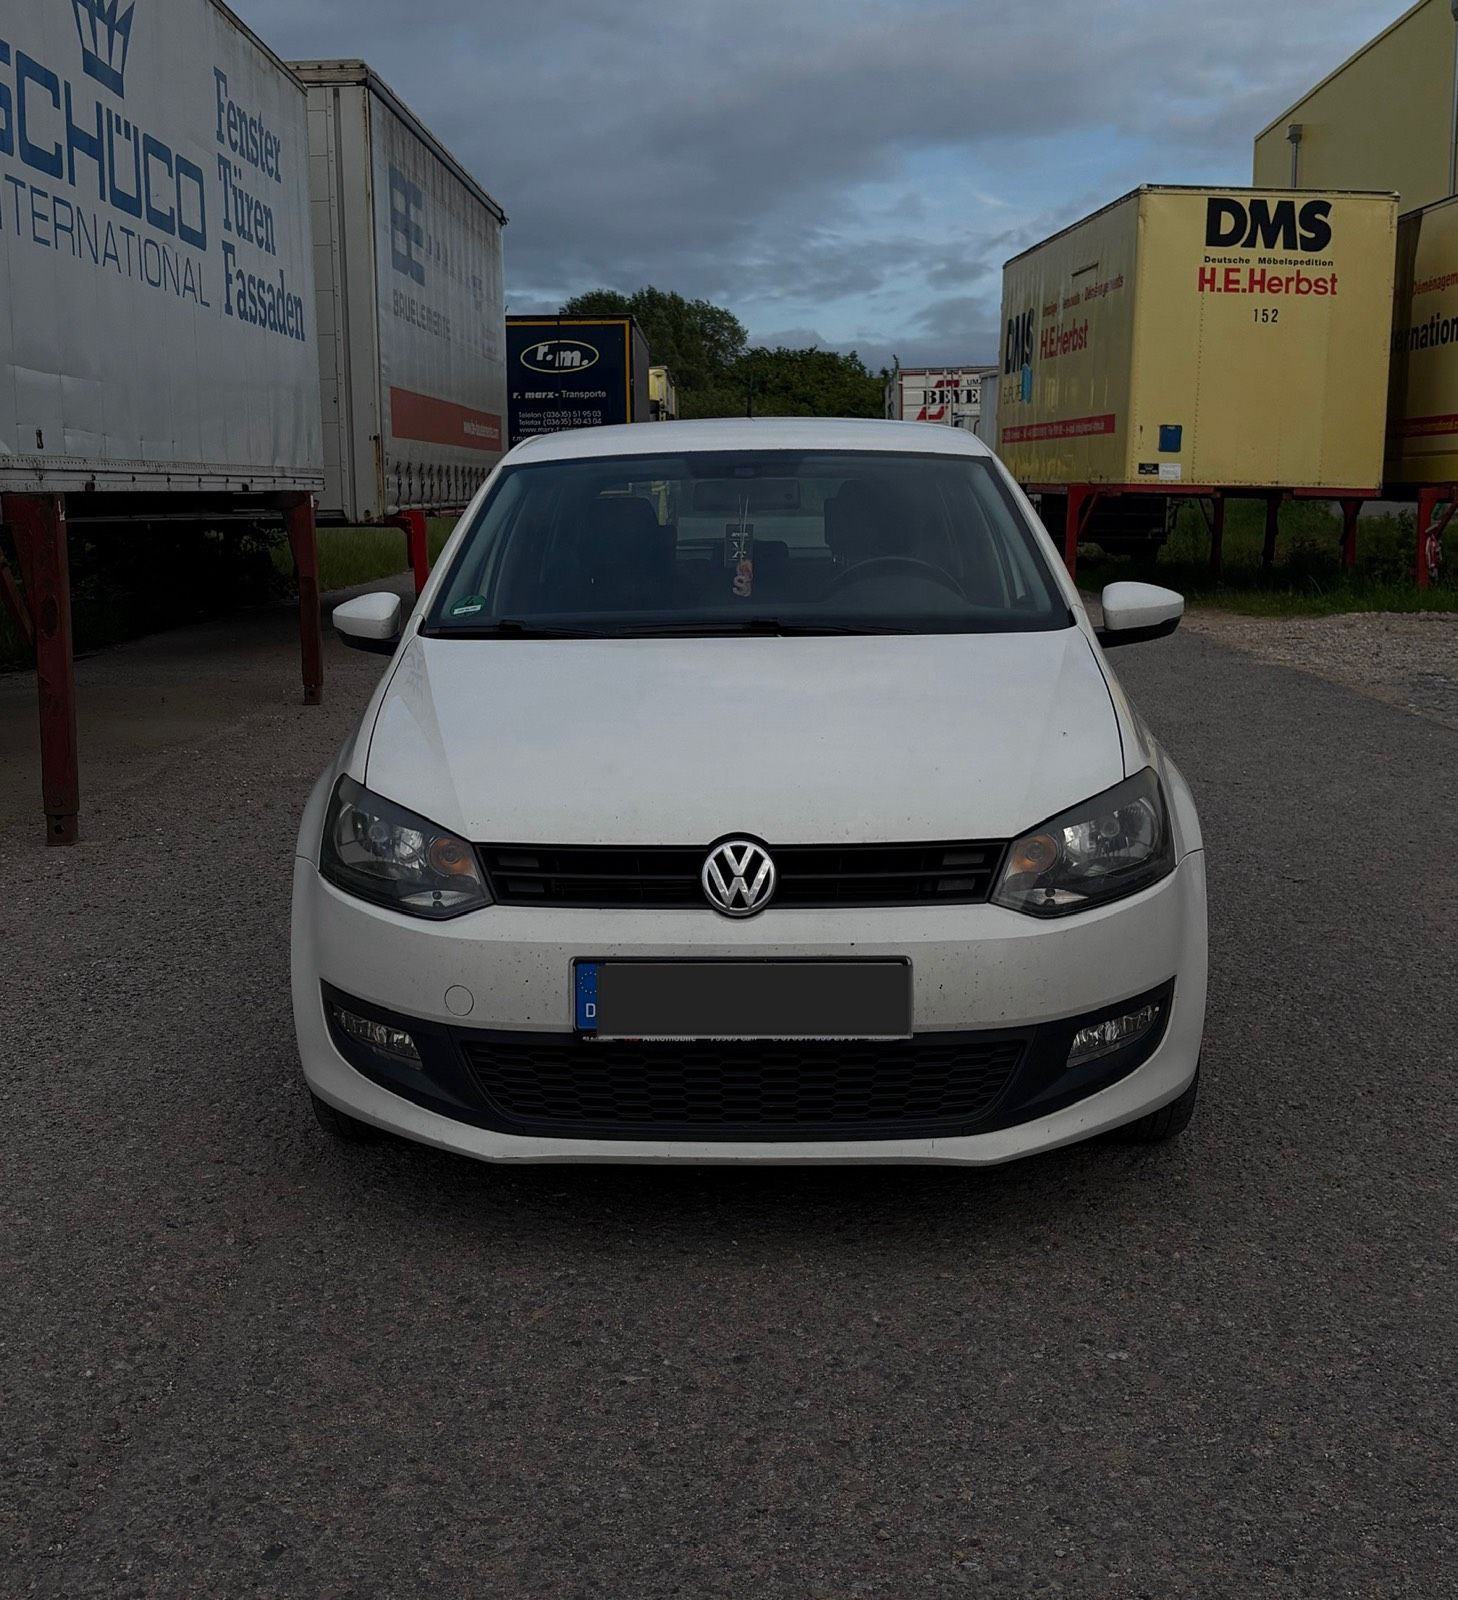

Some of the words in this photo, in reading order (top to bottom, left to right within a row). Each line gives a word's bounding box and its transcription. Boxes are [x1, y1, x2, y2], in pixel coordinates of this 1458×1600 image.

[0, 39, 207, 252] CHÜCO
[213, 66, 282, 183] Fenster
[217, 153, 276, 256] Türen
[1205, 197, 1333, 252] DMS
[0, 173, 211, 308] TERNATIONAL
[1204, 256, 1250, 265] Deutsche
[1258, 256, 1334, 267] Möbelspedition
[221, 240, 305, 342] Fassaden
[1197, 267, 1338, 296] H.E.Herbst
[1005, 308, 1035, 374] DMS
[1253, 308, 1279, 323] 152
[562, 390, 606, 399] Transporte
[923, 389, 982, 405] BEYE
[585, 1002, 596, 1018] D
